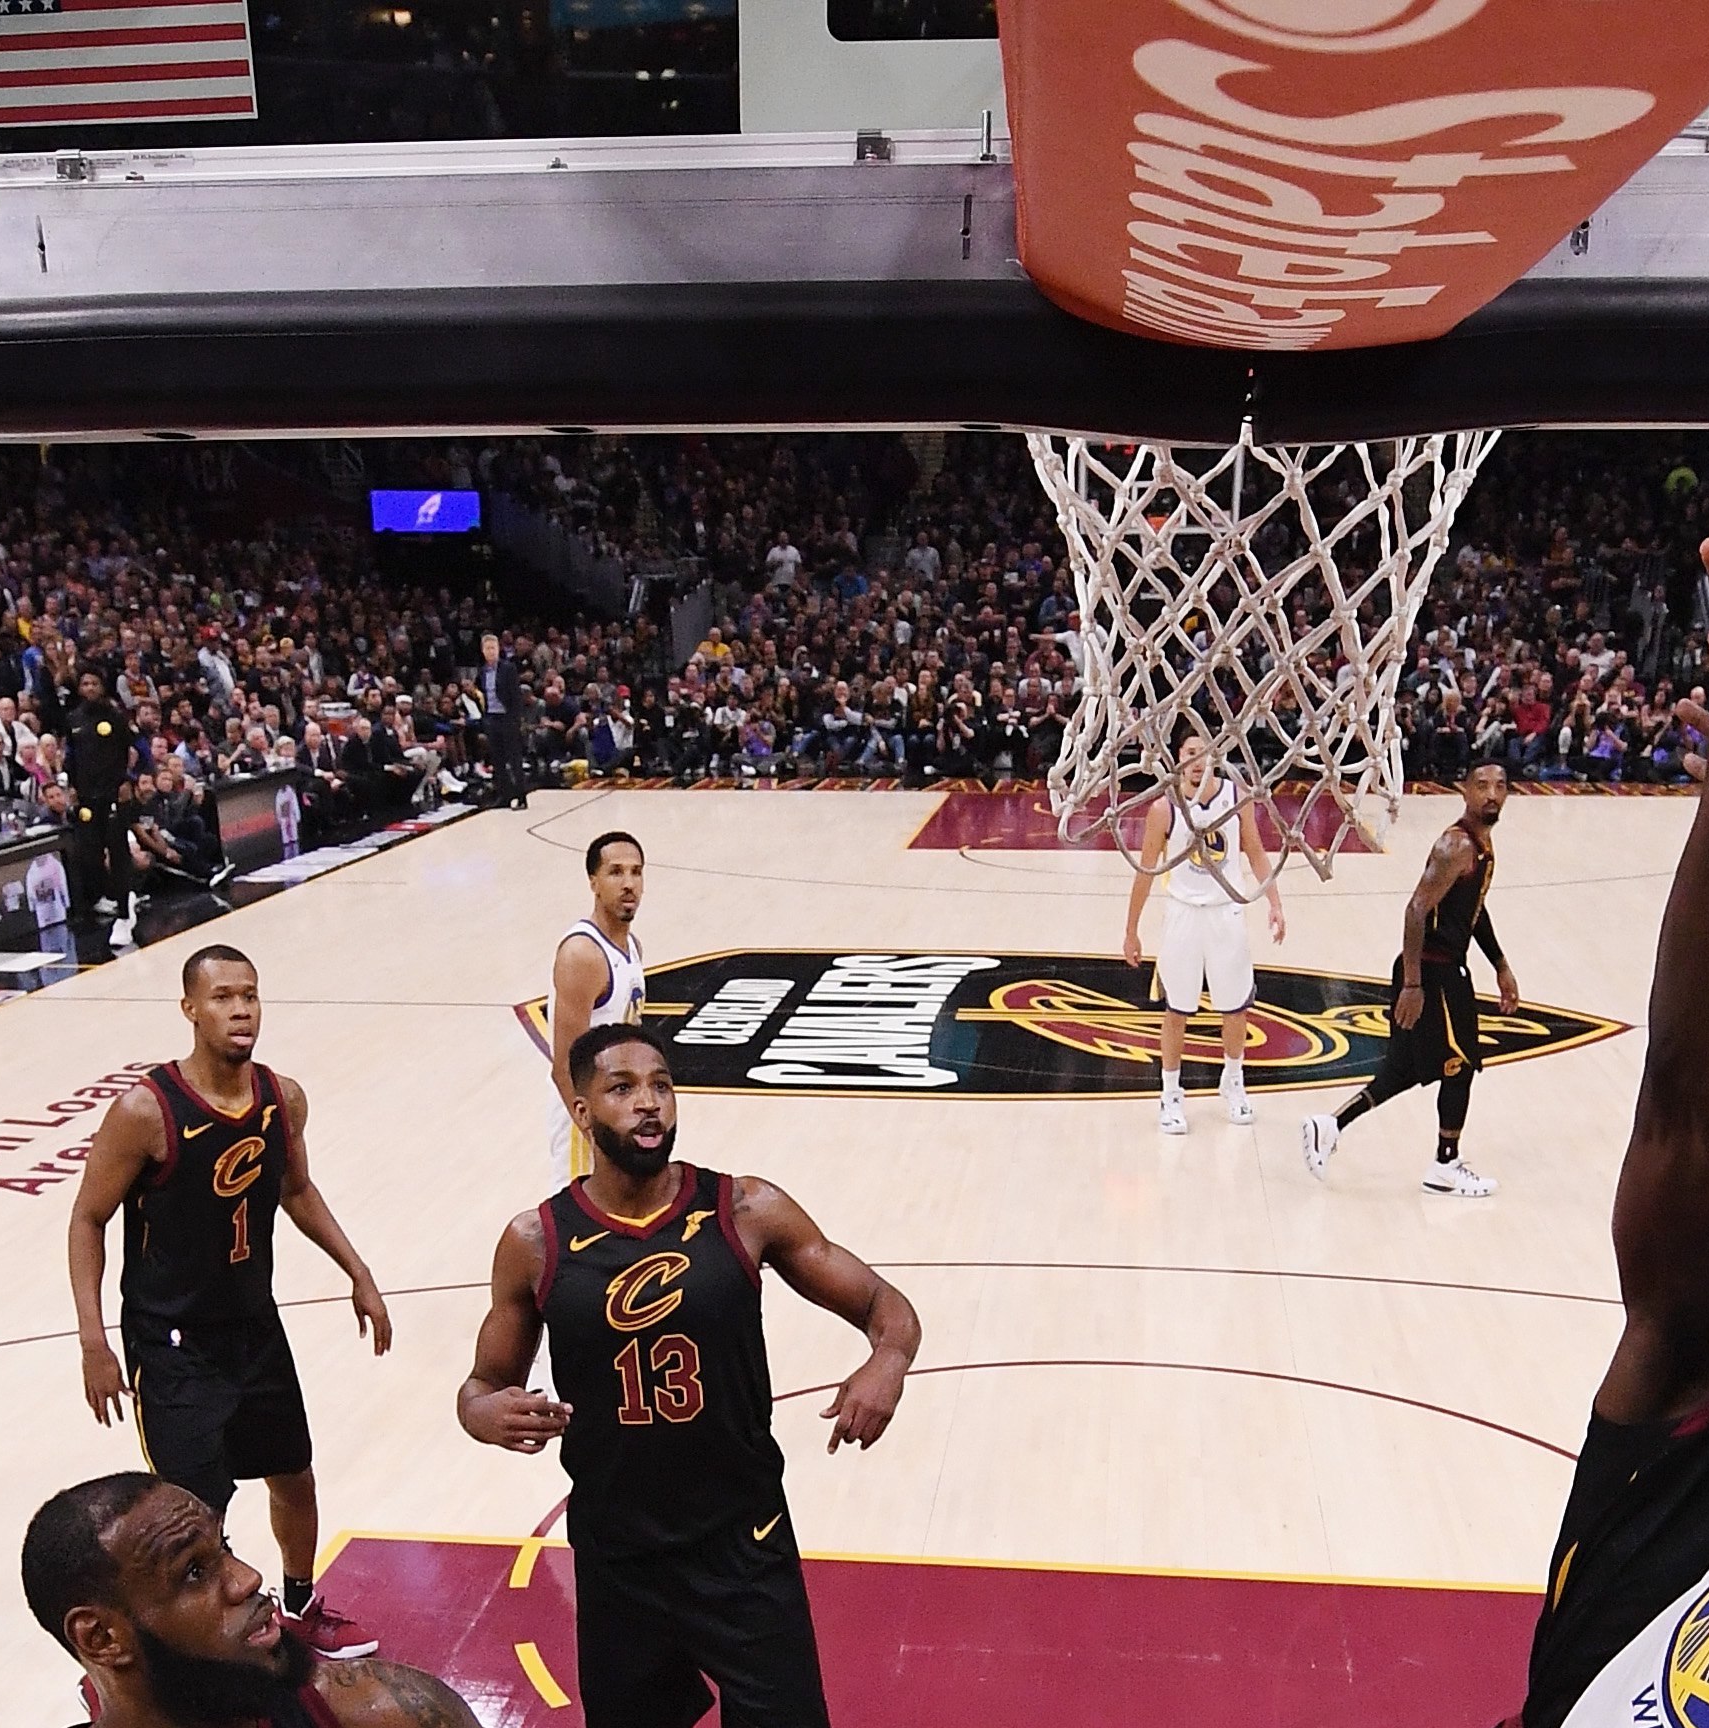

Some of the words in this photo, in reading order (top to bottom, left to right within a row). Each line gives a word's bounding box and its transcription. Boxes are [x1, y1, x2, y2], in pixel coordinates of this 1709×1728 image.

[1127, 38, 1657, 286] State
[673, 978, 796, 1045] CLEVELAND
[746, 955, 1002, 1087] CAVALIERS
[228, 1197, 253, 1265] 1
[614, 1333, 705, 1425] 13
